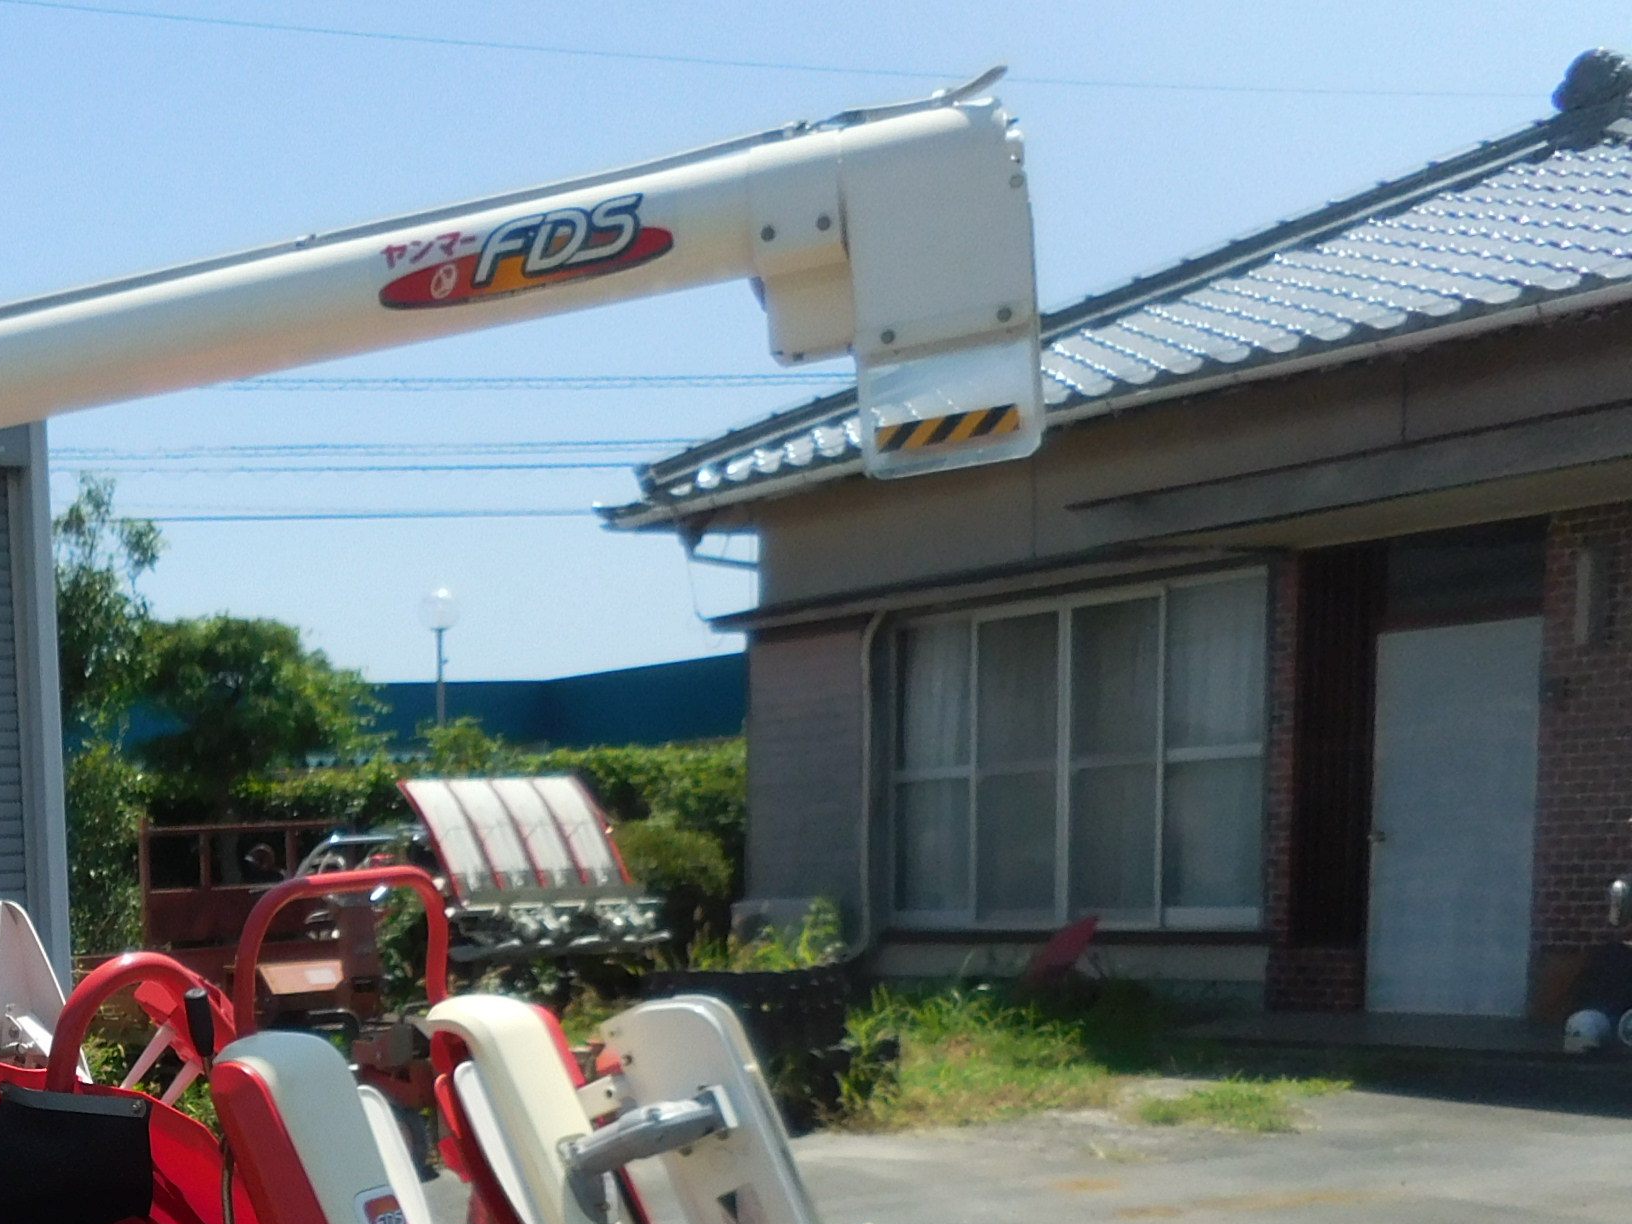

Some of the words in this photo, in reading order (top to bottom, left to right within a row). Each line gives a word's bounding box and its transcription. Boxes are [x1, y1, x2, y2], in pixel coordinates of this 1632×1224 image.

[380, 232, 476, 270] ヤンマー
[473, 193, 645, 288] FDS
